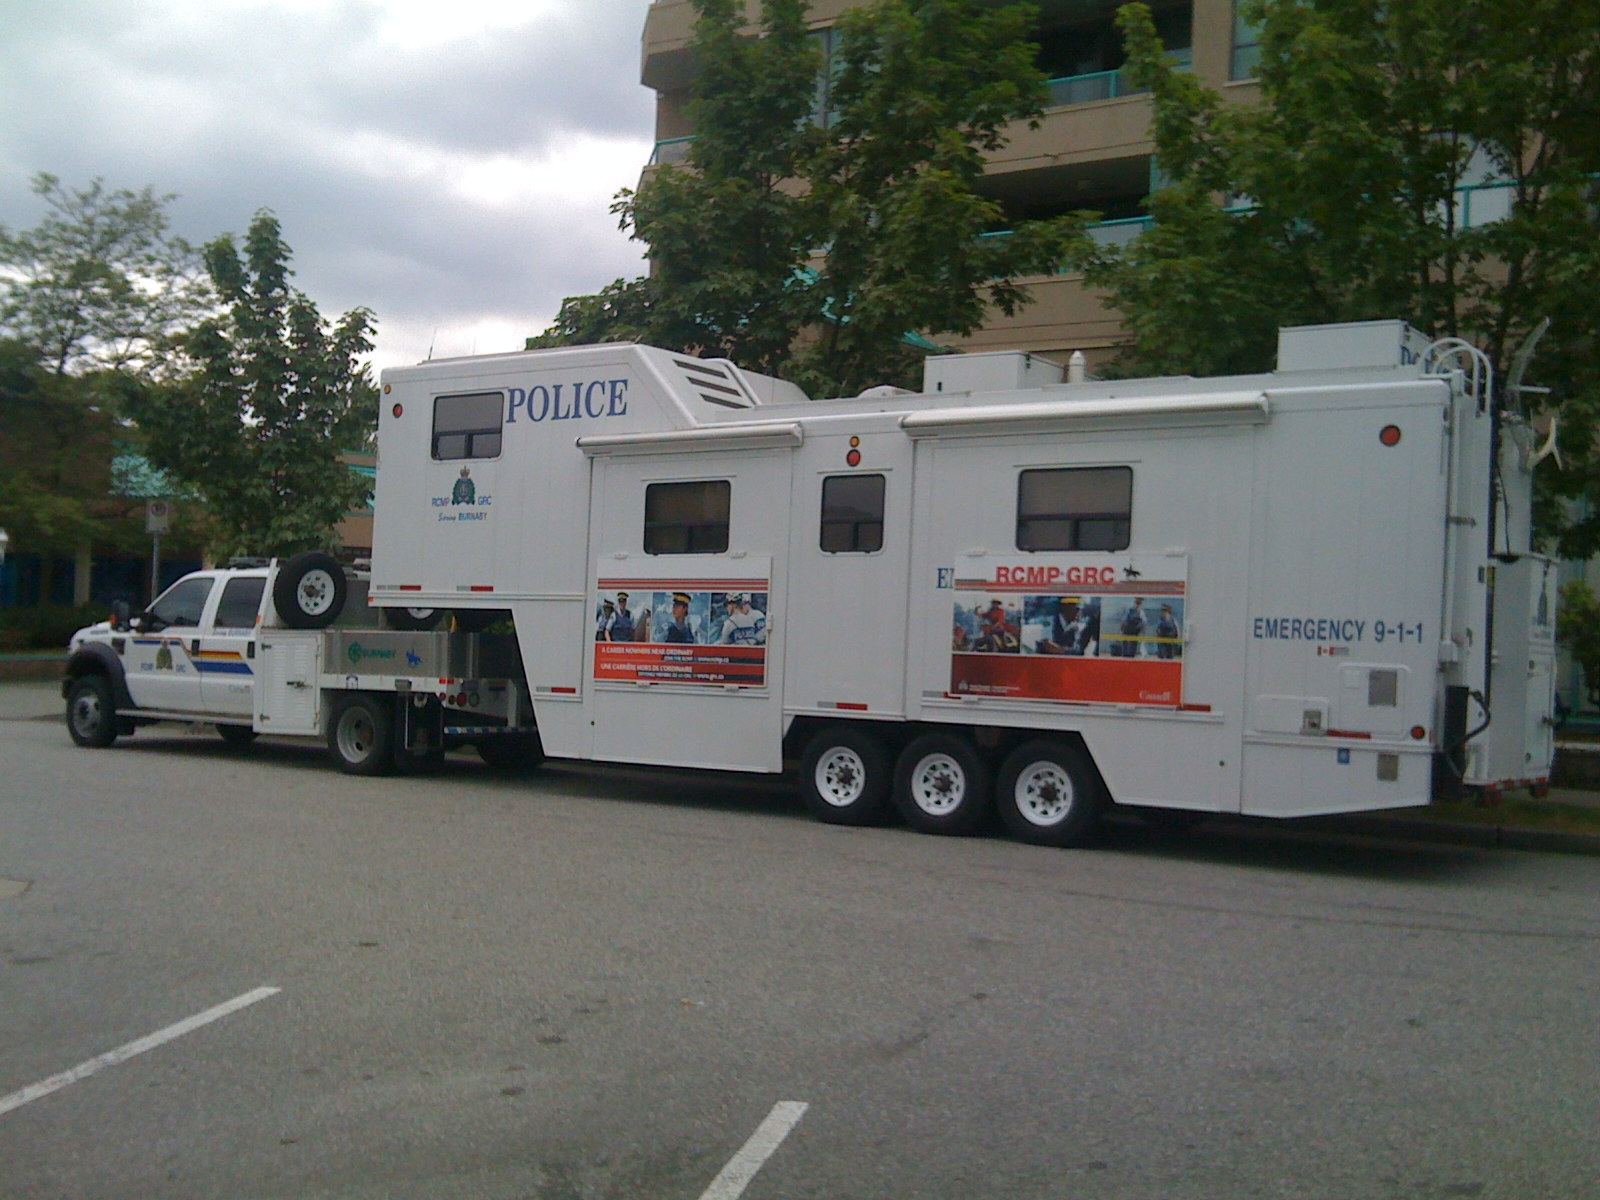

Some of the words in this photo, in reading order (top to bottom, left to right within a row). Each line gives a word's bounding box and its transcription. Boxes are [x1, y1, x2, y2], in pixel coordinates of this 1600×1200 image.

[506, 379, 628, 423] POLICE
[1253, 617, 1365, 642] EMERGENCY
[1374, 620, 1423, 644] 9-1-1
